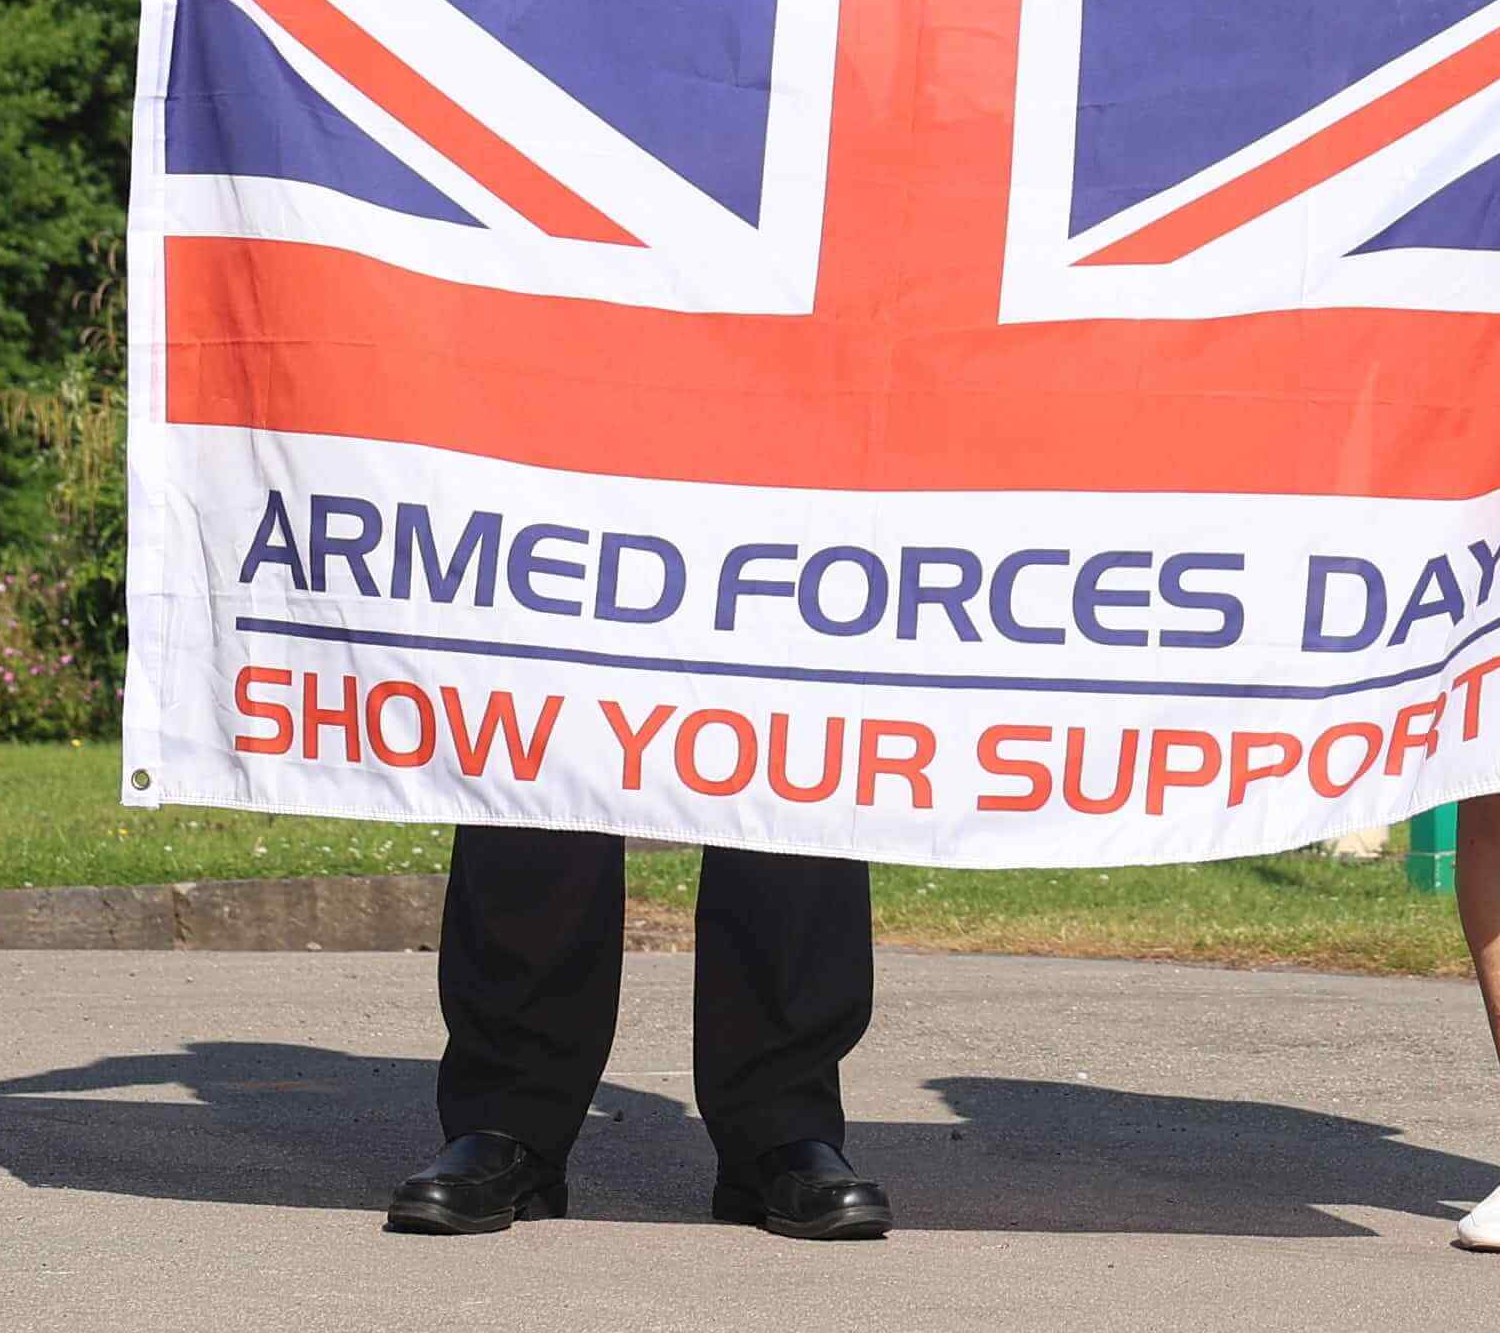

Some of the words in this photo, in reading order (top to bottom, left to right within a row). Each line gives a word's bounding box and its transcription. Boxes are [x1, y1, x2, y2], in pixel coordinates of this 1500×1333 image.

[238, 488, 685, 623] ARMED
[716, 543, 1245, 648] FORCES
[234, 665, 565, 783] SHOW
[598, 700, 937, 810] YOUR
